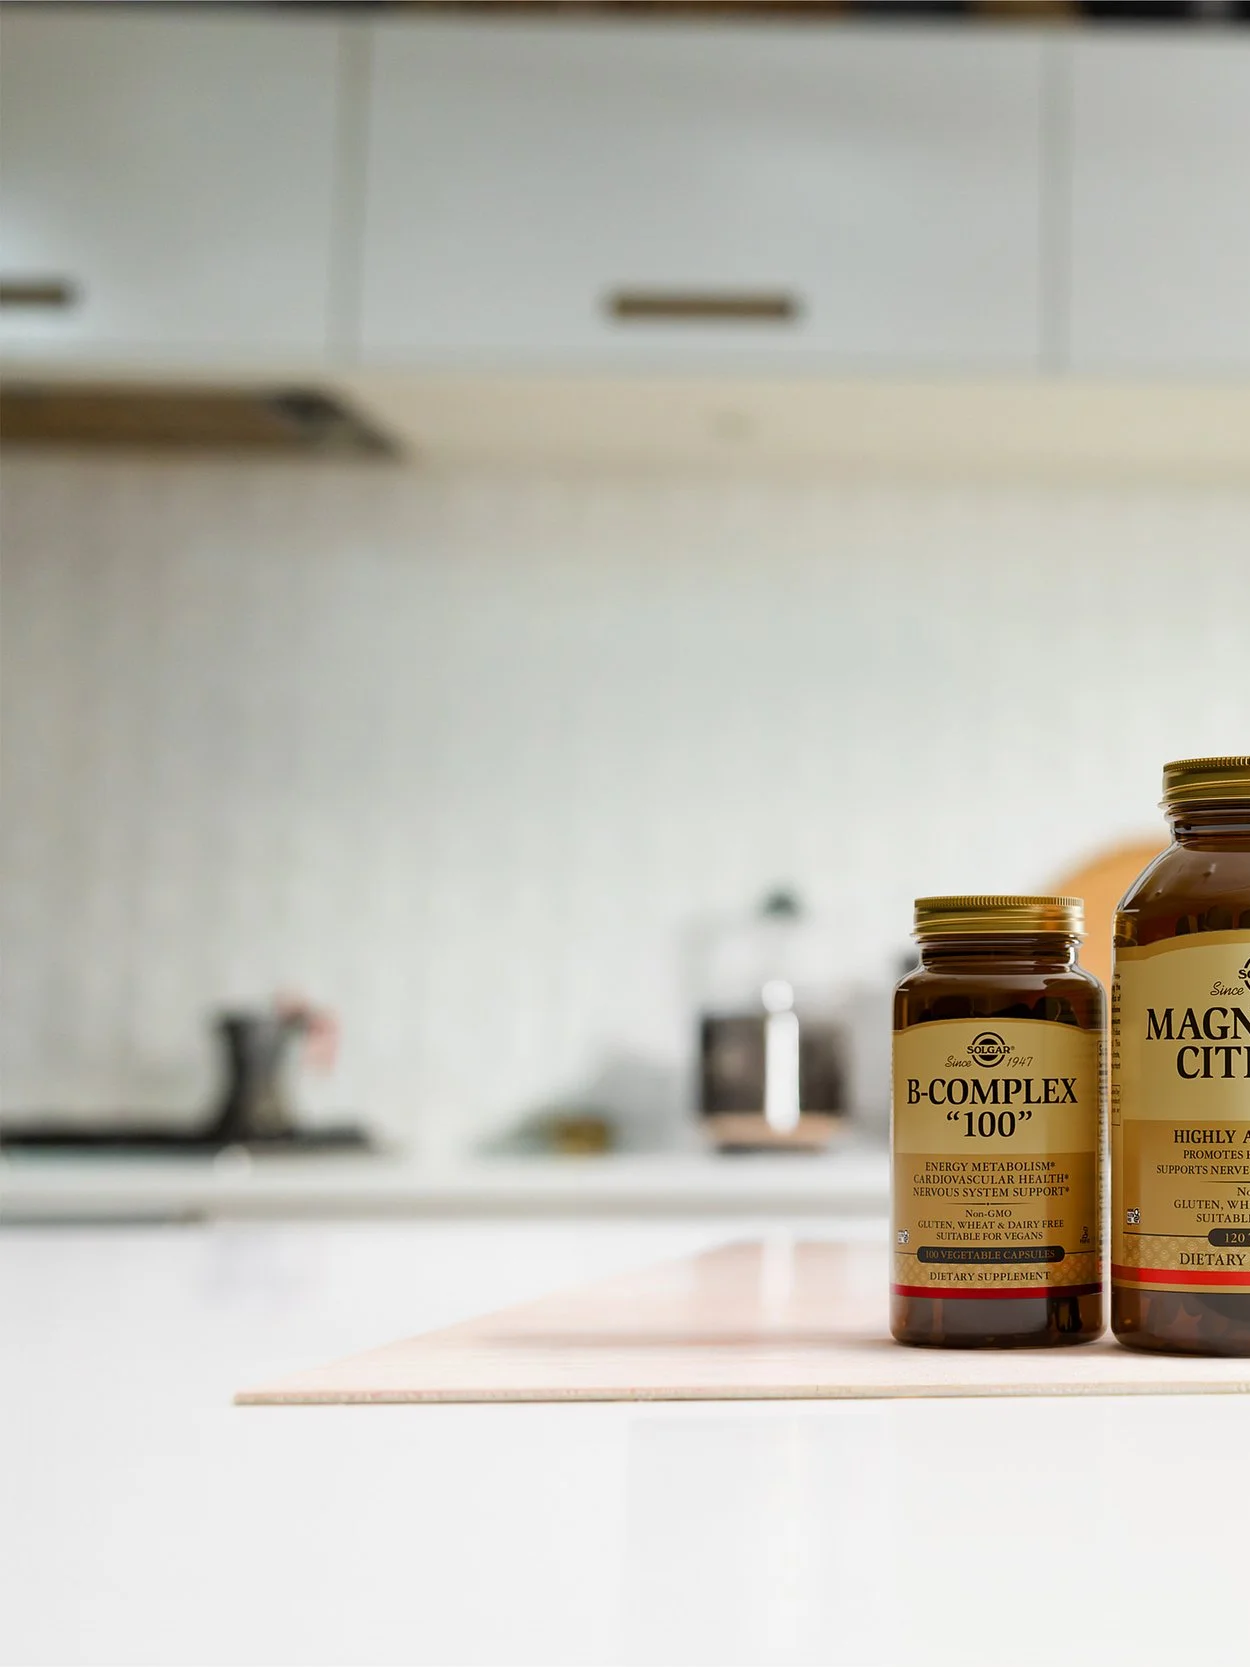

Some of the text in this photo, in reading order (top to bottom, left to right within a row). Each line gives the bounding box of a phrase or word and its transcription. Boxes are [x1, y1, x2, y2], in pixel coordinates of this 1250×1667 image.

[1210, 981, 1244, 996] Since
[945, 1055, 1033, 1068] Since 1947
[907, 1078, 1078, 1104] B-COMPLEX
[947, 1110, 1032, 1137] “100”
[1174, 1130, 1236, 1144] HIGHLY
[1183, 1149, 1244, 1160] PROMOTES
[925, 1162, 968, 1172] ENERGY
[1156, 1164, 1208, 1175] SUPPORTS
[1210, 1165, 1249, 1175] NERVE
[914, 1174, 1014, 1184] CARDIOVASCULAR
[913, 1187, 959, 1197] NERVOUS
[963, 1188, 1008, 1197] SYSTEM
[1174, 1199, 1224, 1210] GLUTEN,
[966, 1209, 1012, 1218] Non-GMO
[918, 1221, 955, 1229] GLUTEN,
[957, 1221, 994, 1229] WHEAT
[1008, 1221, 1040, 1229] DAIRY
[936, 1232, 1043, 1240] SUITABLE FOR VEGANS
[1224, 1232, 1245, 1243] 120
[926, 1250, 1054, 1259] 100 VEGETABLE CAPSULES
[1180, 1252, 1247, 1266] DIETARY
[930, 1271, 1050, 1281] DIETARY SUPPLEMENT
